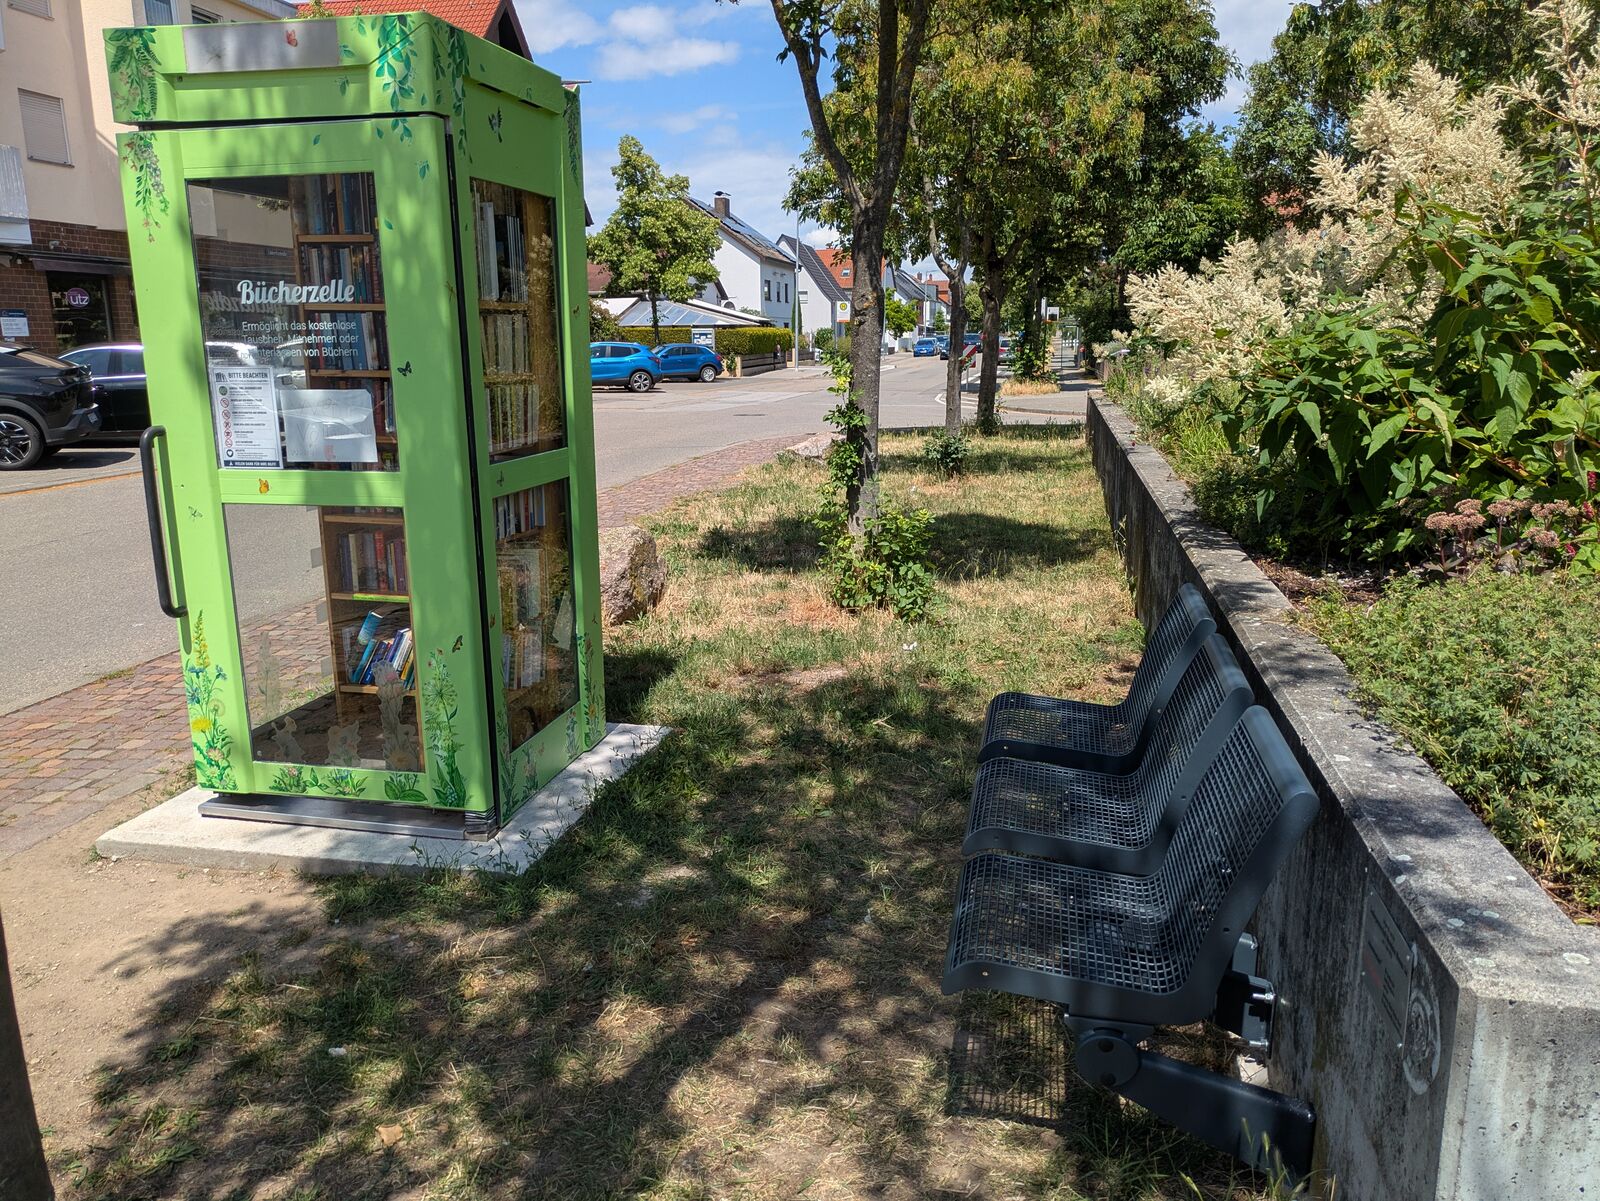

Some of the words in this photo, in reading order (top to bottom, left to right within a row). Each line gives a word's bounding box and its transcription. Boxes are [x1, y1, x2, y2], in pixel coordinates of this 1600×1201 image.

[237, 279, 355, 305] Bücherzelle
[70, 293, 89, 305] utz
[242, 320, 289, 333] Ermöglicht
[290, 320, 307, 330] das
[308, 320, 357, 330] kostenlose
[287, 333, 337, 344] Mitnehmen
[339, 333, 359, 343] oder
[303, 348, 320, 357] von
[322, 346, 359, 357] Büchern
